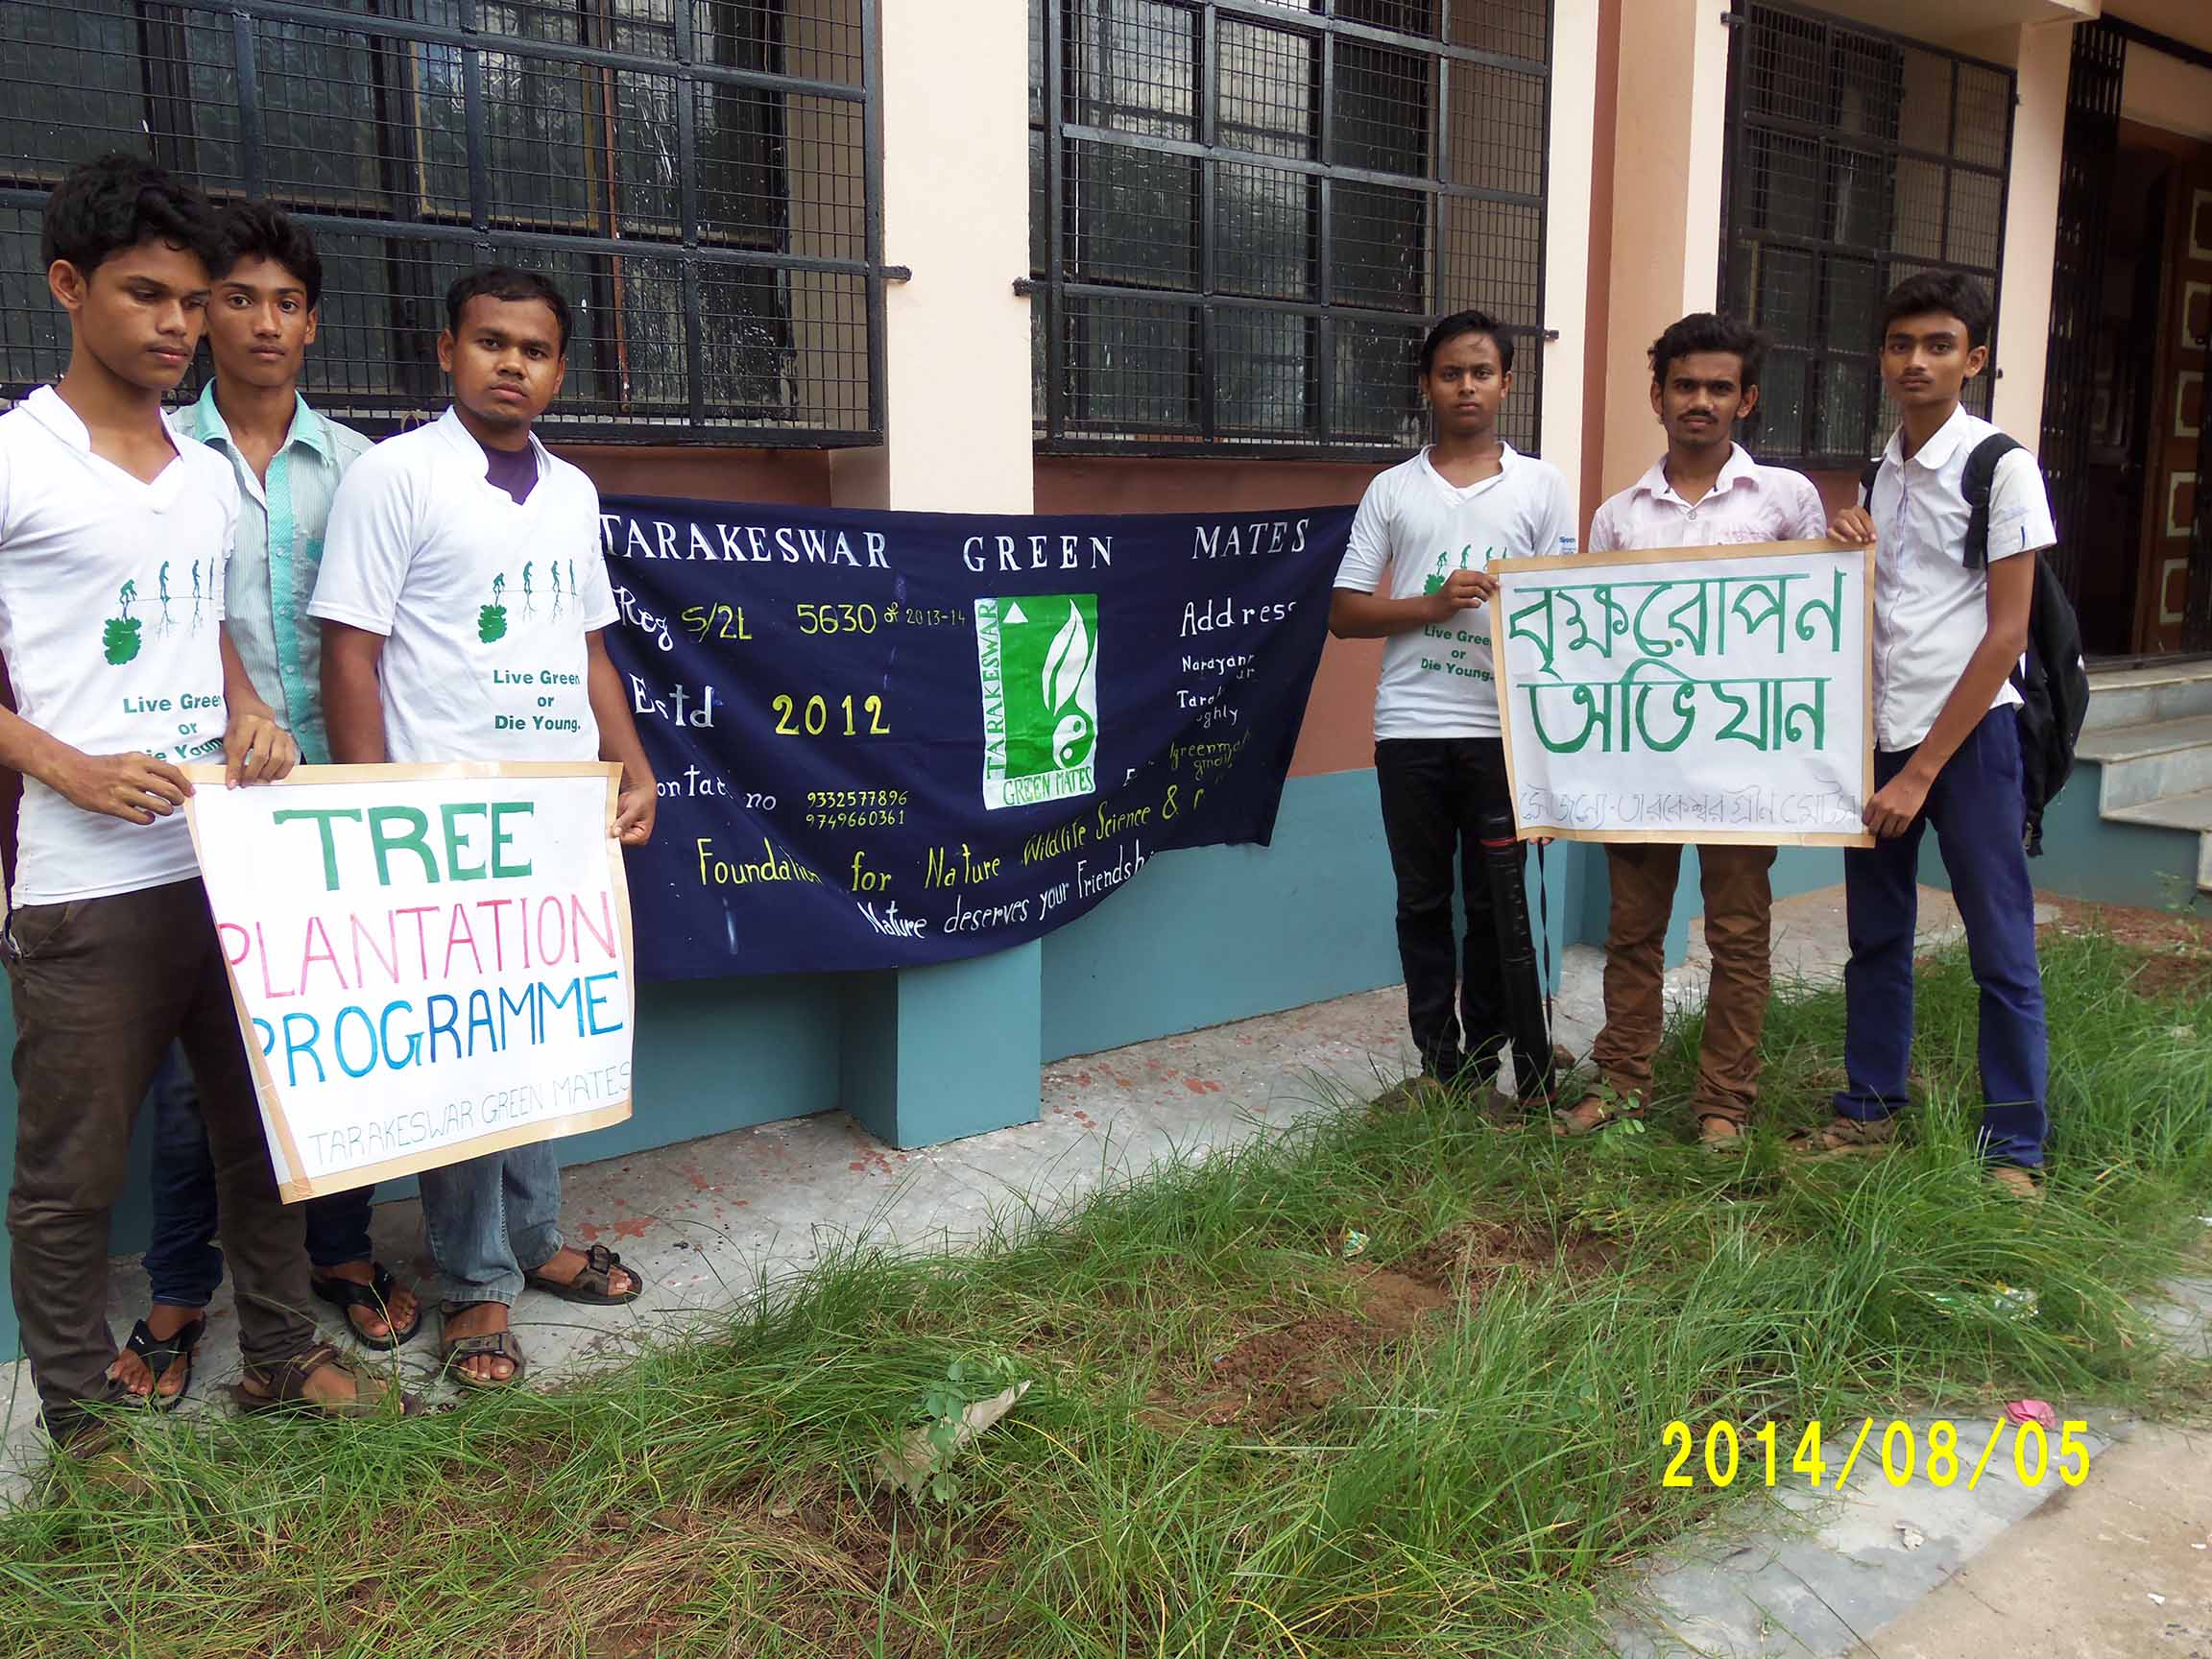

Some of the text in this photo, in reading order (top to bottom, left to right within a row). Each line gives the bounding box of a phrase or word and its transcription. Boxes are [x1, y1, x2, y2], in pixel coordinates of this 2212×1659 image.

[599, 514, 1310, 572] TARAKESWAR GREEN MATES
[612, 586, 674, 652] Reg
[796, 604, 877, 635] 5630
[905, 608, 966, 627] 2013-14
[1425, 624, 1491, 645] Live Gree
[1421, 659, 1441, 670] Die
[1451, 650, 1466, 660] or
[493, 669, 534, 685] Live
[977, 603, 1007, 780] TARAKESWAR
[123, 693, 222, 713] Live Gree
[537, 696, 554, 708] or
[772, 694, 891, 736] 2012
[178, 722, 197, 735] or
[494, 715, 581, 733] Die Young.
[746, 792, 777, 810] no
[806, 789, 909, 808] 9332577896
[1002, 776, 1051, 806] GREEN
[1054, 766, 1094, 801] MATES
[805, 809, 904, 830] 9749660361
[272, 801, 536, 892] TREE
[851, 851, 892, 891] for
[923, 843, 1000, 889] Nature
[1095, 801, 1151, 841] Science
[1161, 783, 1179, 820] &
[856, 900, 927, 939] Nature
[944, 894, 1029, 934] deserves
[1039, 880, 1070, 922] your
[217, 890, 617, 999] PLANTATION
[307, 1060, 632, 1167] TARAKESWAR GREEN MATES
